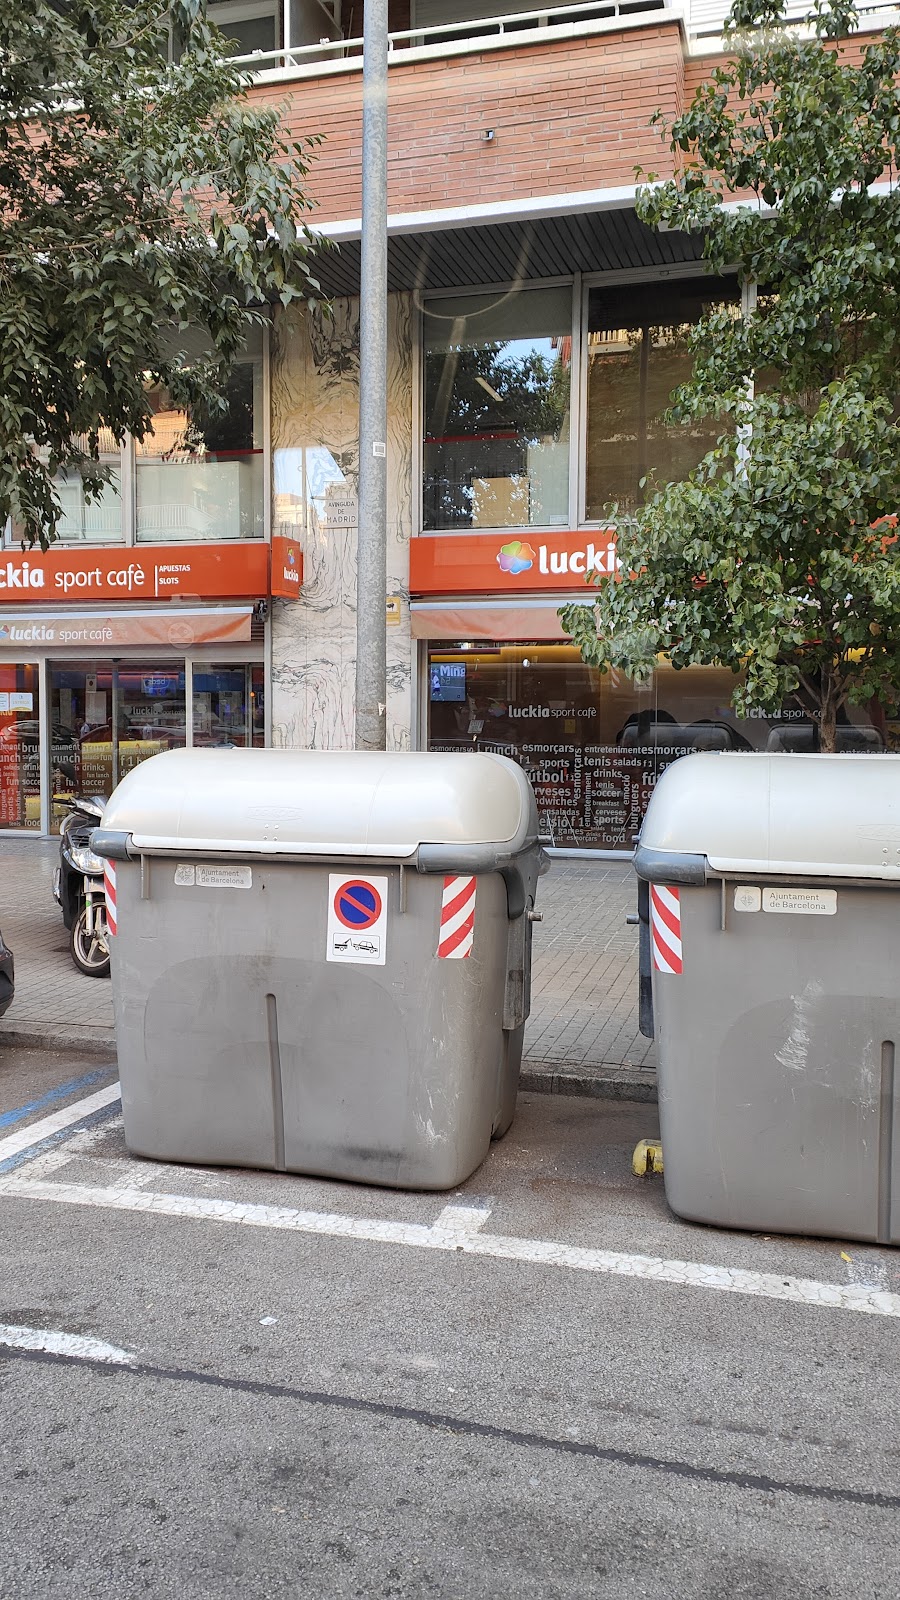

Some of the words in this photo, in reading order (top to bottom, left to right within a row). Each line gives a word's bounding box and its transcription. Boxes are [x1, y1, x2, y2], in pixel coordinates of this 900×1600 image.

[327, 515, 356, 523] MADRID
[55, 567, 102, 593] sport
[106, 564, 145, 591] cafè
[283, 567, 299, 582] luckia
[158, 577, 179, 585] SLOTS
[9, 626, 55, 641] luckia
[59, 628, 88, 643] sport
[89, 627, 113, 642] cafè
[508, 704, 550, 718] luckia
[551, 709, 575, 720] sport
[577, 707, 597, 719] cafè
[522, 744, 574, 754] esmorçars
[584, 746, 641, 754] entreteniment
[641, 746, 697, 758] esmorçars
[540, 759, 570, 769] sports
[584, 756, 611, 766] tenis
[613, 758, 642, 767] salads
[574, 748, 582, 800] esmorçars
[593, 769, 623, 778] drinks
[6, 777, 19, 786] fun
[595, 781, 615, 789] tenis
[591, 790, 621, 798] soccer
[584, 772, 592, 828] entreteniment
[629, 783, 641, 830] burguers
[542, 808, 580, 816] ensaladas
[593, 816, 625, 826] sports
[558, 828, 584, 836] games
[602, 832, 626, 843] food
[201, 868, 240, 878] Ajuntament
[211, 877, 244, 885] Barcelona
[769, 892, 819, 901] Ajuntament
[782, 901, 826, 910] Barcelona
